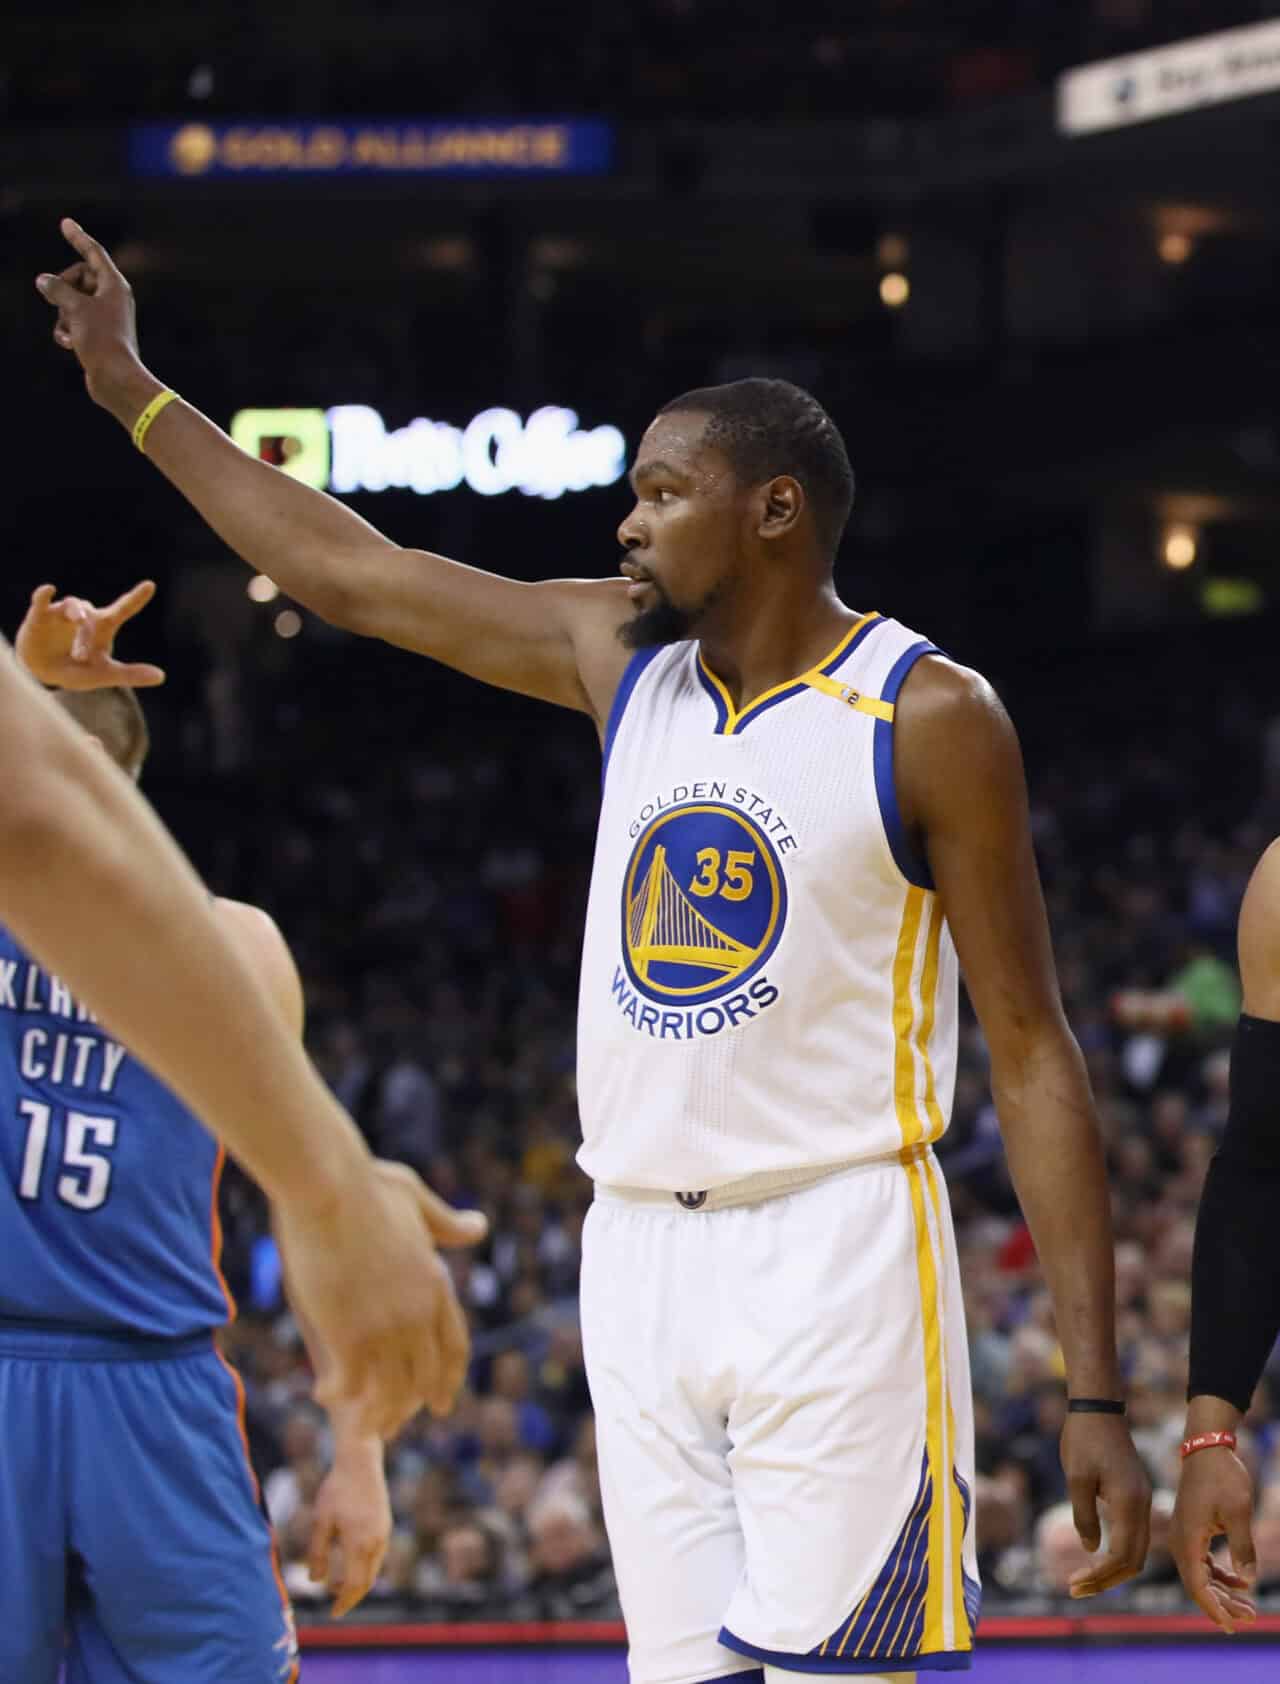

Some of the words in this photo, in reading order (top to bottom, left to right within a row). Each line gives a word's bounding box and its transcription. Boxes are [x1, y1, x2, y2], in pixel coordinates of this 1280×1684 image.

[222, 126, 345, 170] GOLD
[352, 124, 567, 170] ALLIANCE
[628, 782, 726, 840] GOLDEN
[732, 787, 798, 854] STATE
[688, 847, 756, 902] 35
[610, 965, 779, 1040] WARRIORS
[20, 1027, 127, 1093] CITY
[18, 1098, 117, 1211] 15
